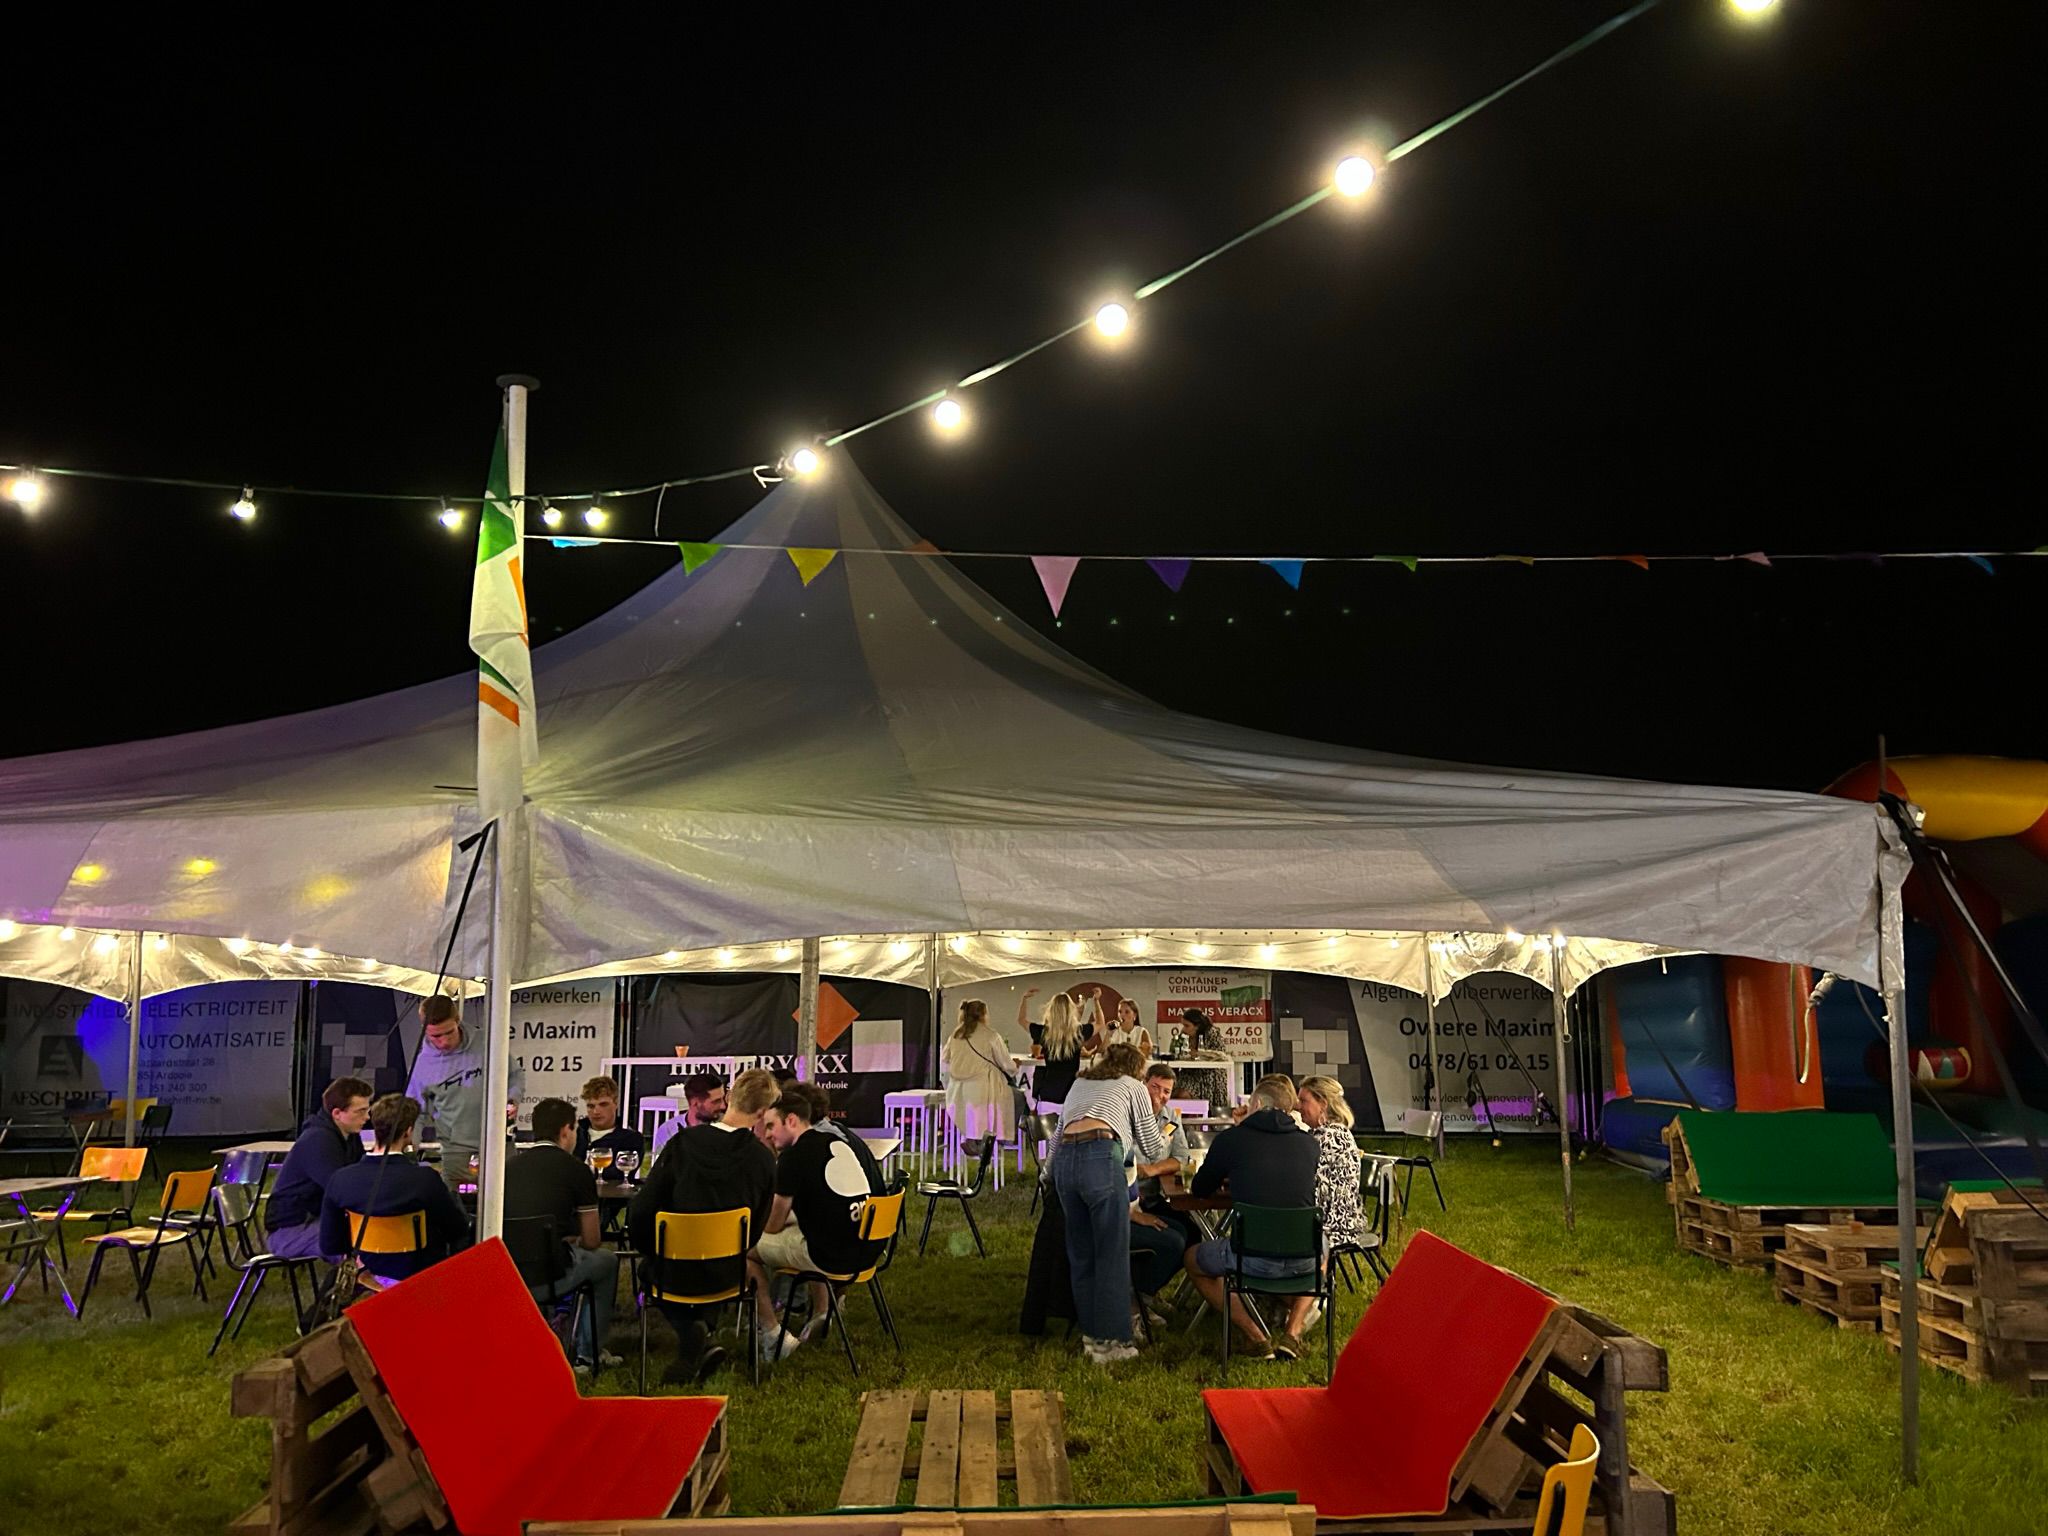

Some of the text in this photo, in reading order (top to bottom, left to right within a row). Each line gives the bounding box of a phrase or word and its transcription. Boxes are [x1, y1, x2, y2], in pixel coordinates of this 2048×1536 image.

[1168, 976, 1228, 986] CONTAINER
[1168, 985, 1218, 994] VERHUUR
[510, 987, 601, 1004] oerwerken
[1452, 983, 1554, 1001] vloerwerke
[148, 1000, 288, 1018] ELEKTRICITEIT
[1217, 1007, 1264, 1017] VERACX
[523, 1020, 597, 1039] Maxim
[1225, 1026, 1241, 1037] 47
[1245, 1026, 1262, 1037] 60
[139, 1032, 286, 1050] AUTOMATISATIE
[532, 1055, 554, 1072] 02
[561, 1055, 583, 1072] 15
[1495, 1053, 1520, 1070] 02
[1526, 1053, 1550, 1070] 15
